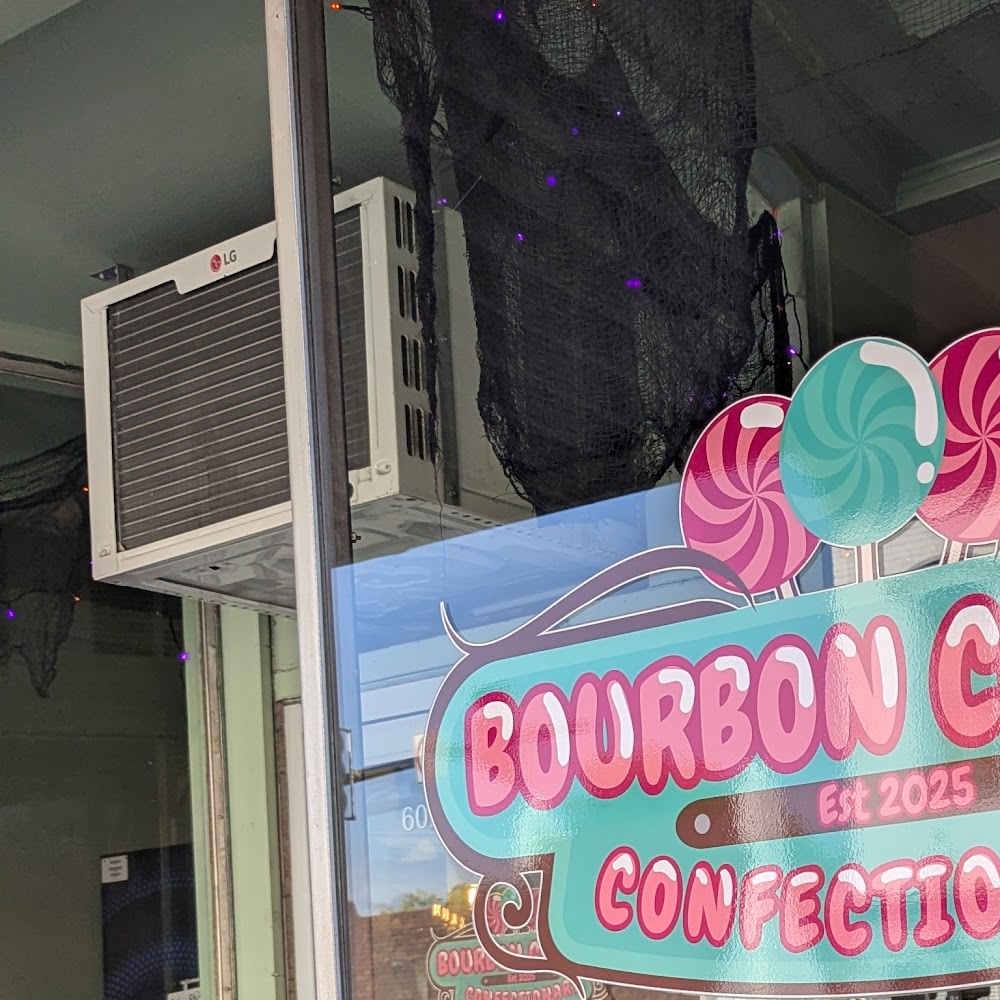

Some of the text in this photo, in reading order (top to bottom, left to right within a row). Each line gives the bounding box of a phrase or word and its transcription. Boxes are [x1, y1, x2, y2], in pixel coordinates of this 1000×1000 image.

[224, 250, 237, 265] LG
[464, 615, 907, 816] BOURBON
[402, 804, 434, 831] 60
[817, 761, 978, 828] Est 2025
